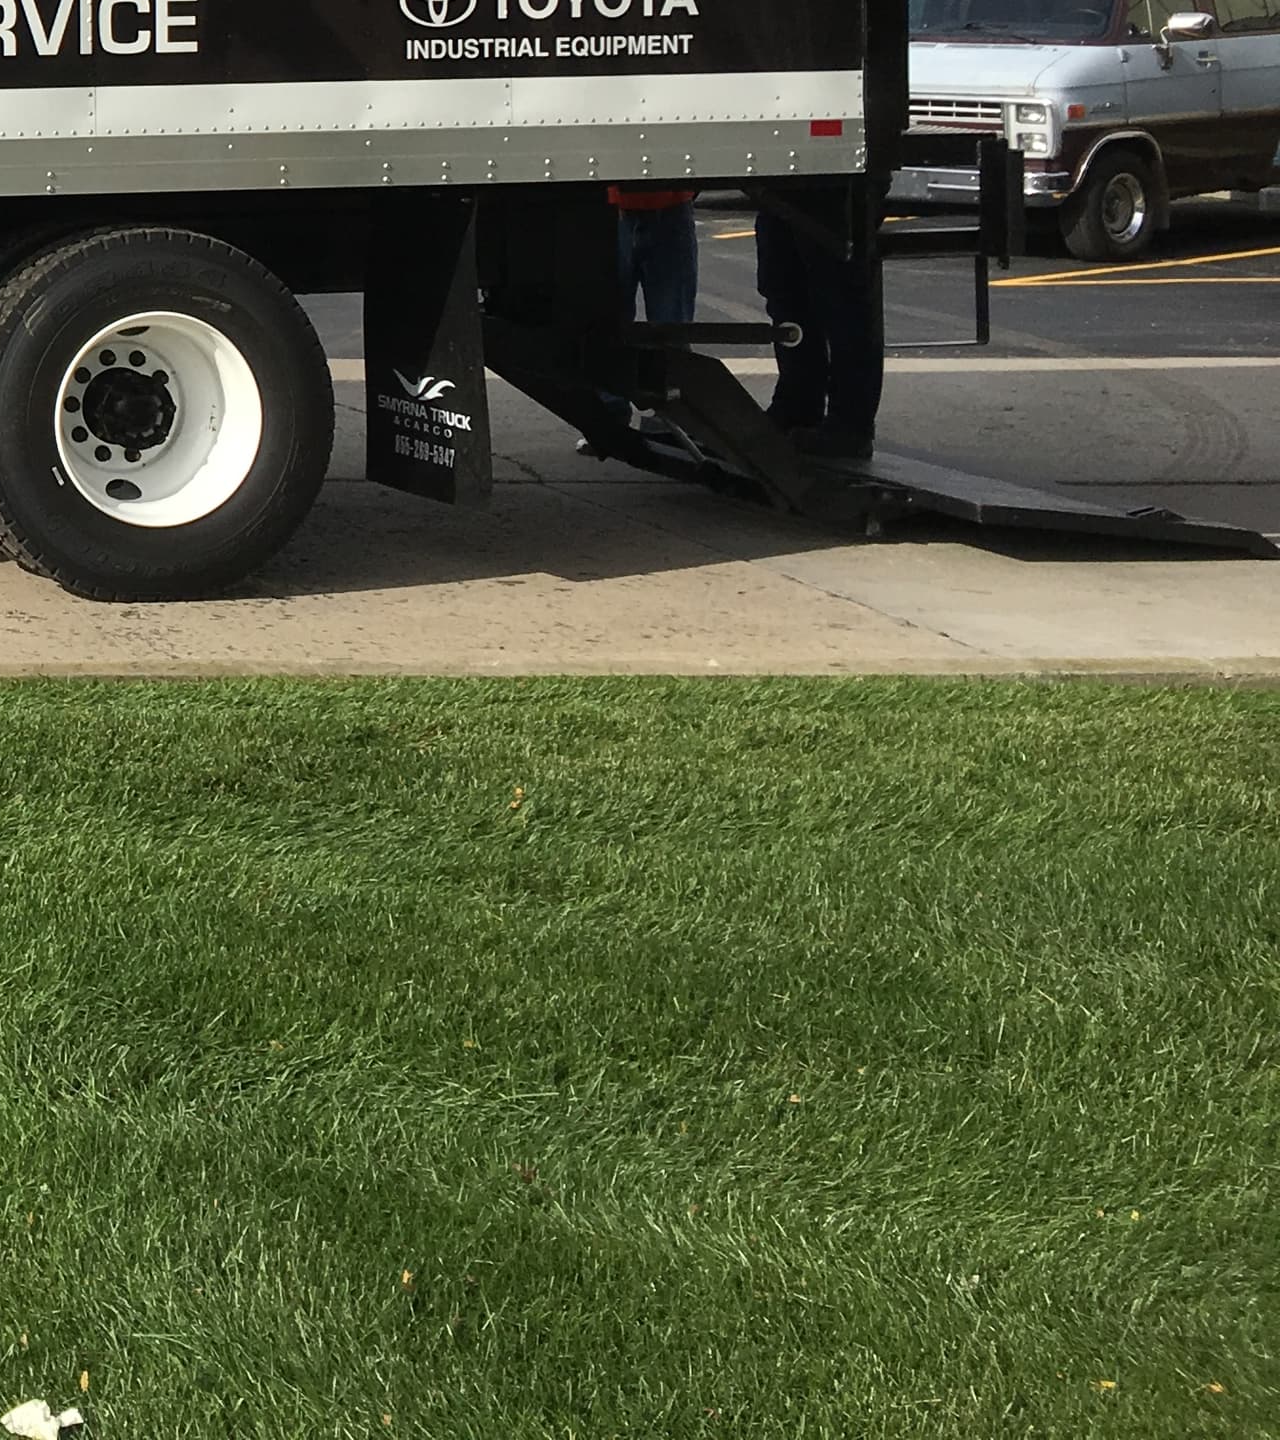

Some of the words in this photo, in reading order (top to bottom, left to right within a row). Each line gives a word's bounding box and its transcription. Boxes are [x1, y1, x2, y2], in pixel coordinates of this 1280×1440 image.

[406, 36, 549, 60] INDUSTRIAL
[556, 34, 694, 58] EQUIPMENT
[378, 394, 428, 420] SMYRNA
[429, 406, 472, 431] TRUCK
[404, 418, 453, 438] CARGO
